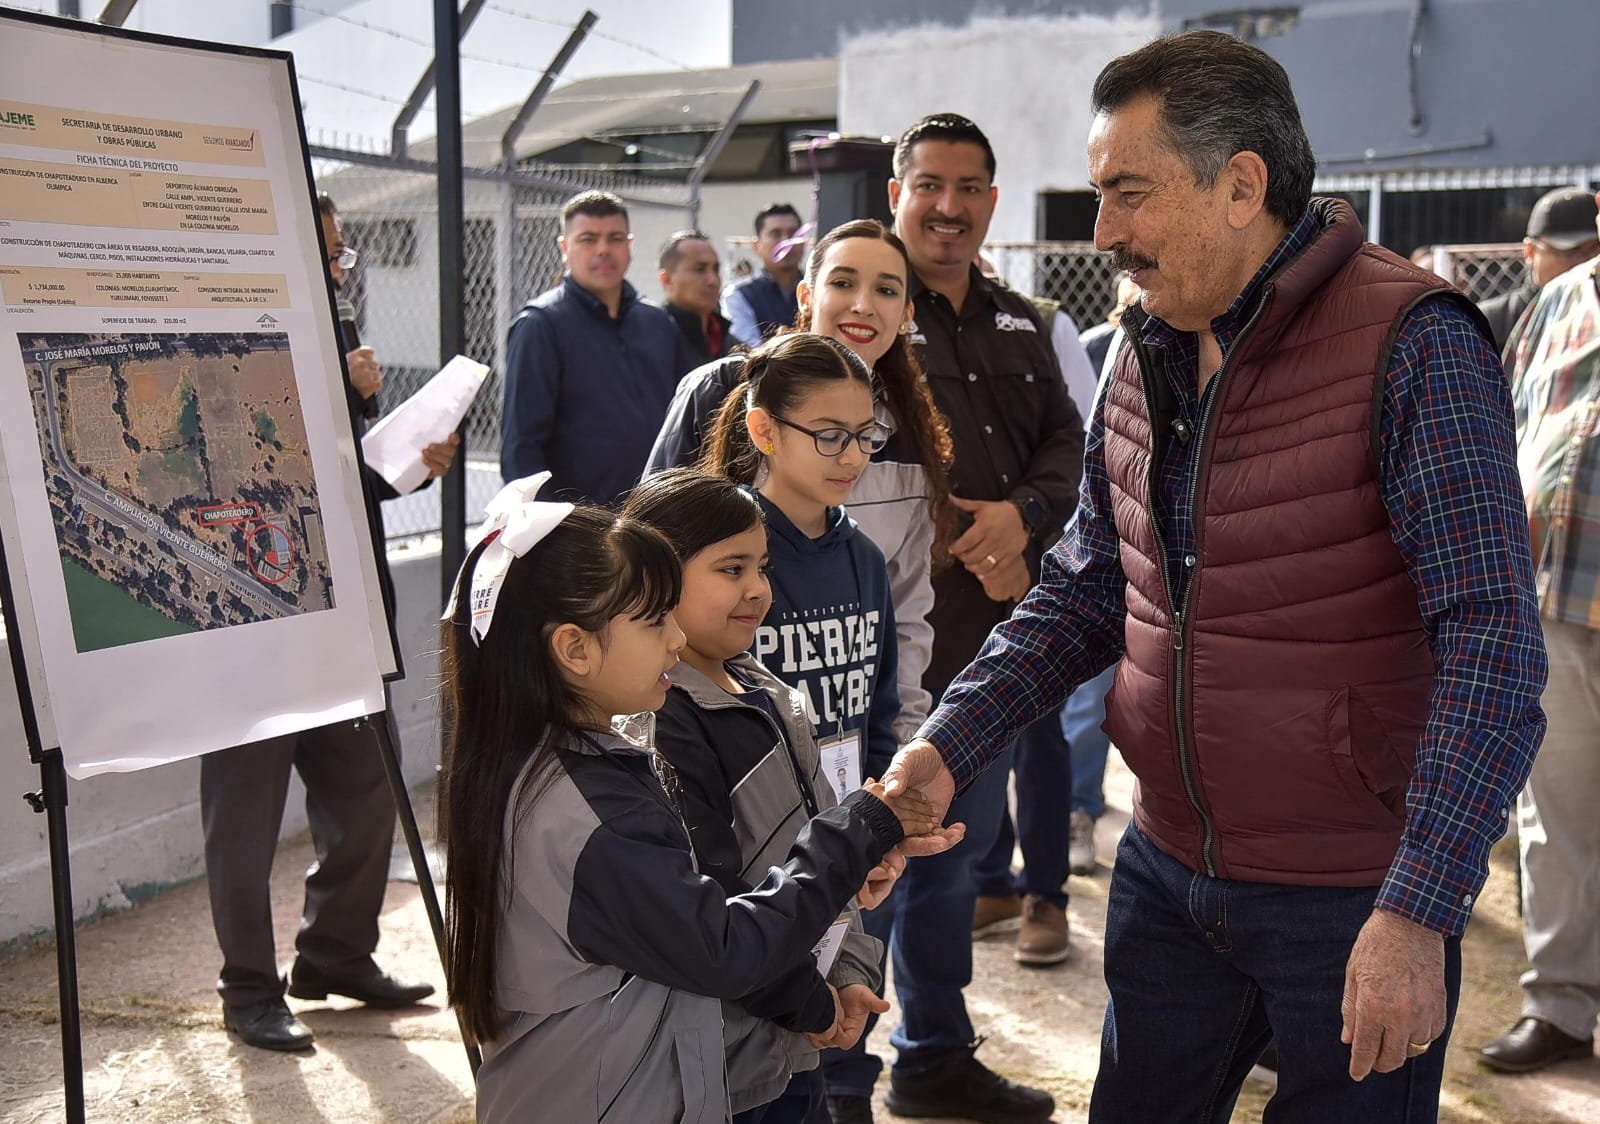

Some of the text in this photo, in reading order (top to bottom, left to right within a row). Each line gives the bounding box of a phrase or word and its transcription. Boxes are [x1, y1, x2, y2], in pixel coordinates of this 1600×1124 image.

[61, 118, 183, 139] SECRETARIA DE DESARROLLO URBANO
[97, 136, 156, 149] Y OBRAS PÚBLICAS
[77, 155, 179, 172] FICHA TÉCNICA DEL PROYECTO
[96, 177, 118, 185] ALBERCA
[165, 182, 193, 191] DEPORTIVO
[166, 193, 179, 201] CALLE
[216, 197, 243, 205] GUERRERO
[159, 202, 174, 210] CALLE
[174, 203, 194, 211] VICENTE
[194, 205, 220, 213] GUERRERO
[216, 224, 239, 232] MORELOS
[1, 237, 43, 247] CONSTRUCCIÓN
[52, 241, 94, 250] CHAPOTEADERO
[126, 255, 164, 263] INSTALACIONES
[132, 272, 160, 280] HABITANTES
[45, 348, 63, 360] JOSÉ
[64, 346, 91, 359] MARÍA
[92, 343, 129, 356] MORELOS
[135, 341, 160, 352] PAVÓN
[204, 508, 253, 521] CHAPOTEADERO
[113, 500, 160, 531] AMPLIACIÓN
[160, 526, 189, 549] VICENTE
[189, 544, 228, 572] GUERRERO
[756, 610, 879, 673] PIERRE
